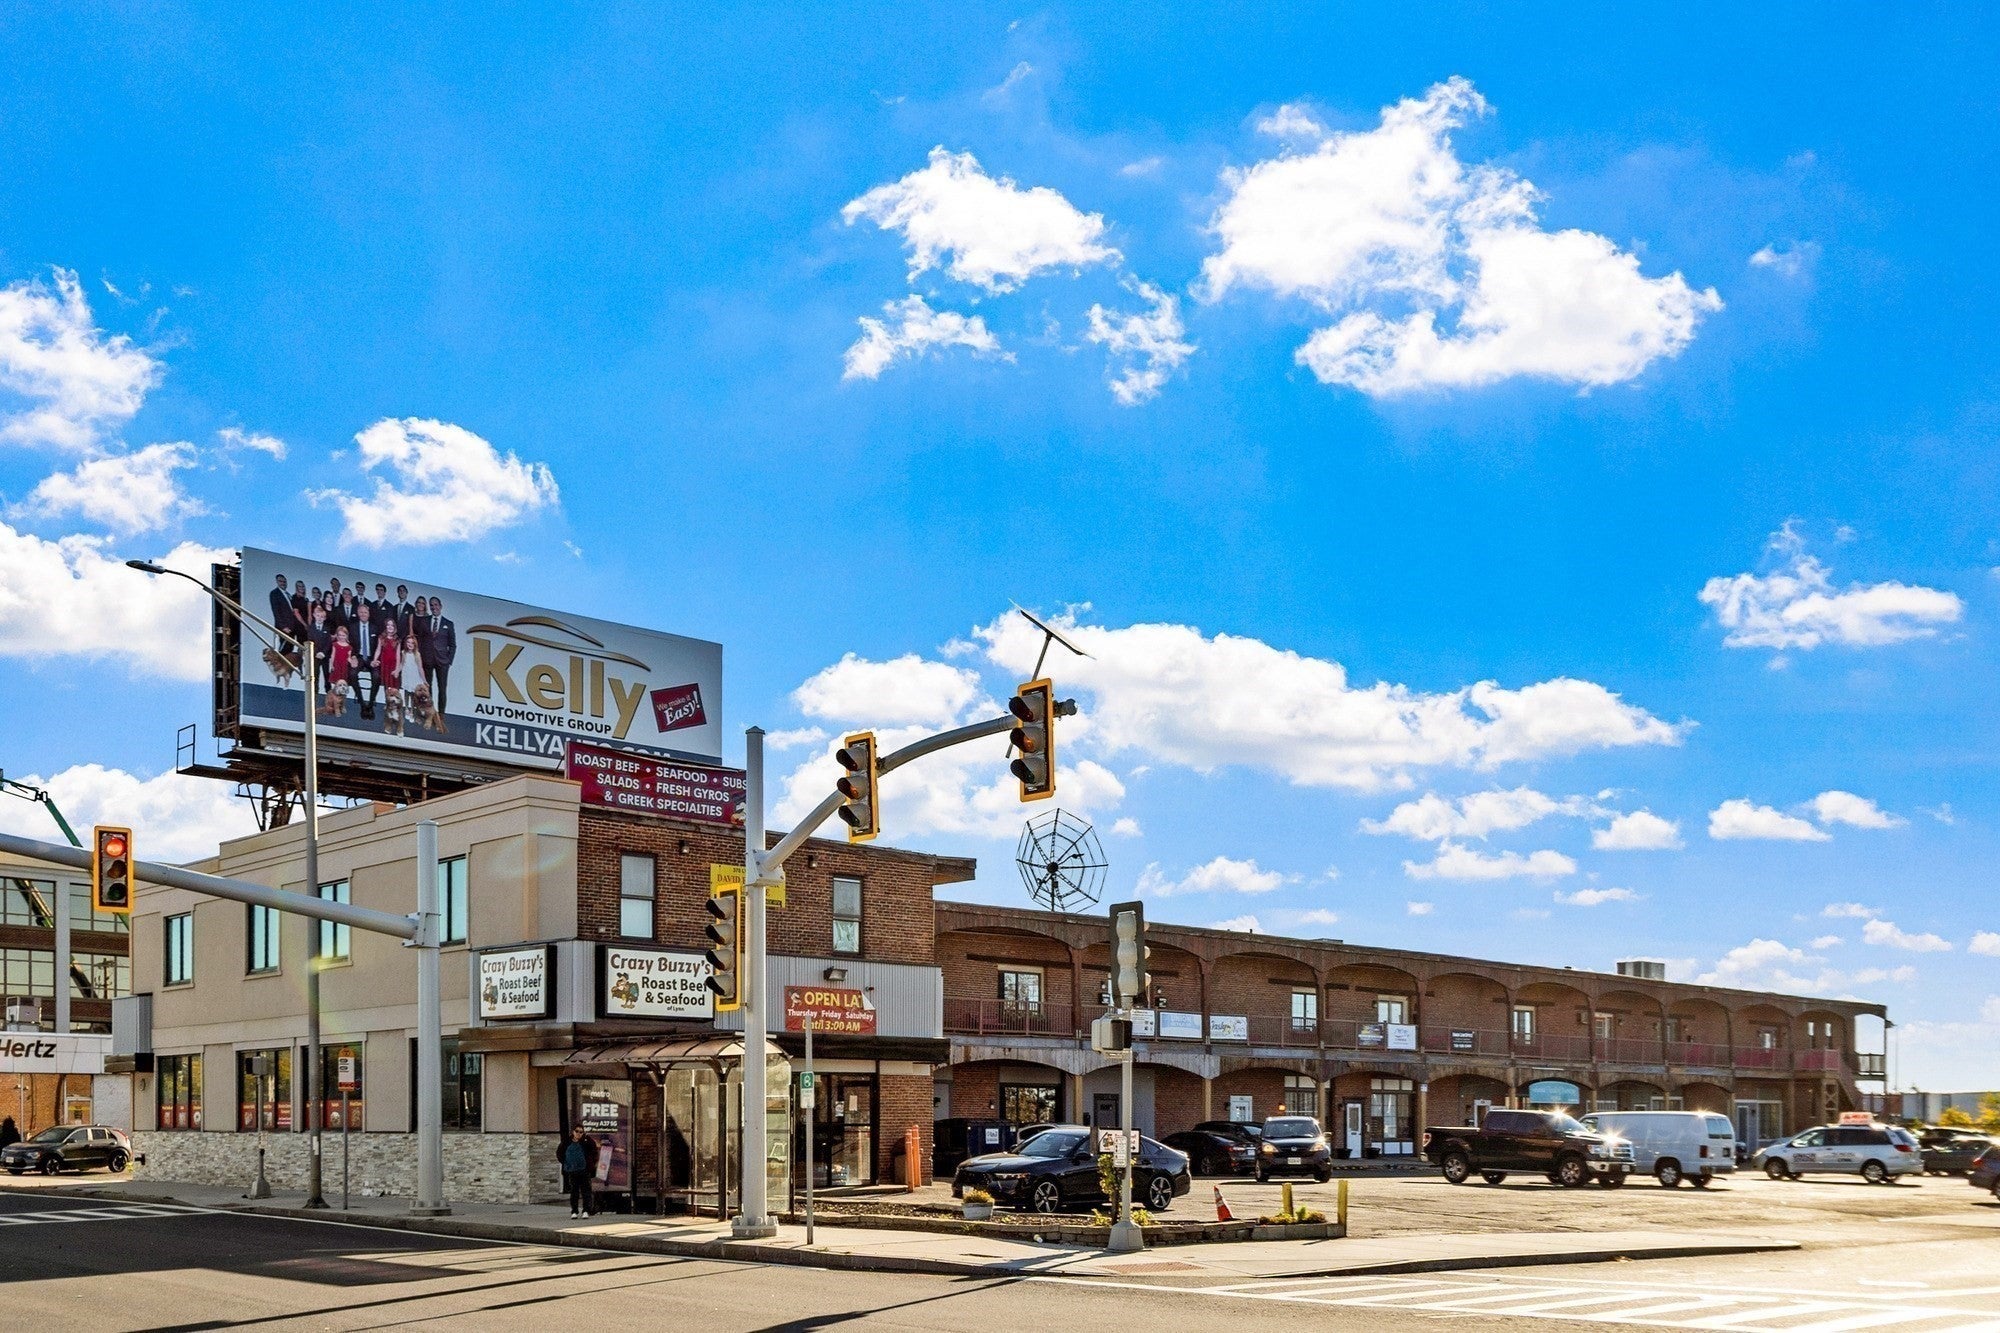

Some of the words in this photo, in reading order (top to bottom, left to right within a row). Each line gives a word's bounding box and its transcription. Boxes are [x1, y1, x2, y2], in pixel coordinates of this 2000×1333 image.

[473, 637, 647, 739] Kelly
[663, 690, 701, 726] Easy!
[668, 697, 686, 707] make
[475, 703, 564, 727] AUTOMOTIVE
[567, 718, 612, 734] GROUP
[574, 753, 612, 770] ROAST
[615, 759, 640, 774] BEEF
[656, 767, 708, 783] SEAFOOD
[722, 776, 747, 790] SUBS
[597, 773, 640, 790] SALADS
[656, 782, 691, 797] FRESH
[693, 788, 730, 802] GYROS
[604, 790, 613, 802] &
[618, 792, 654, 808] GREEK
[656, 799, 723, 817] SPECIALTIES
[717, 874, 741, 883] DAVID
[482, 960, 507, 975] Crazy
[509, 954, 543, 973] Buzzy's
[610, 953, 653, 974] Crazy
[657, 957, 711, 977] Buzzy's
[499, 978, 521, 990] Roast
[523, 974, 542, 988] Beef
[641, 976, 677, 990] Roast
[502, 992, 507, 1004] &
[509, 989, 539, 1003] Seafood
[645, 991, 654, 1003] &
[657, 992, 705, 1006] Seafood
[804, 991, 840, 1007] OPEN
[787, 1008, 818, 1018] Thursday
[821, 1009, 841, 1019] Friday
[845, 1011, 873, 1022] Saturday
[802, 1019, 823, 1030] Util
[825, 1020, 844, 1031] 3:00
[846, 1021, 860, 1031] AM
[0, 1039, 57, 1058] Hertz
[582, 1103, 619, 1117] FREE
